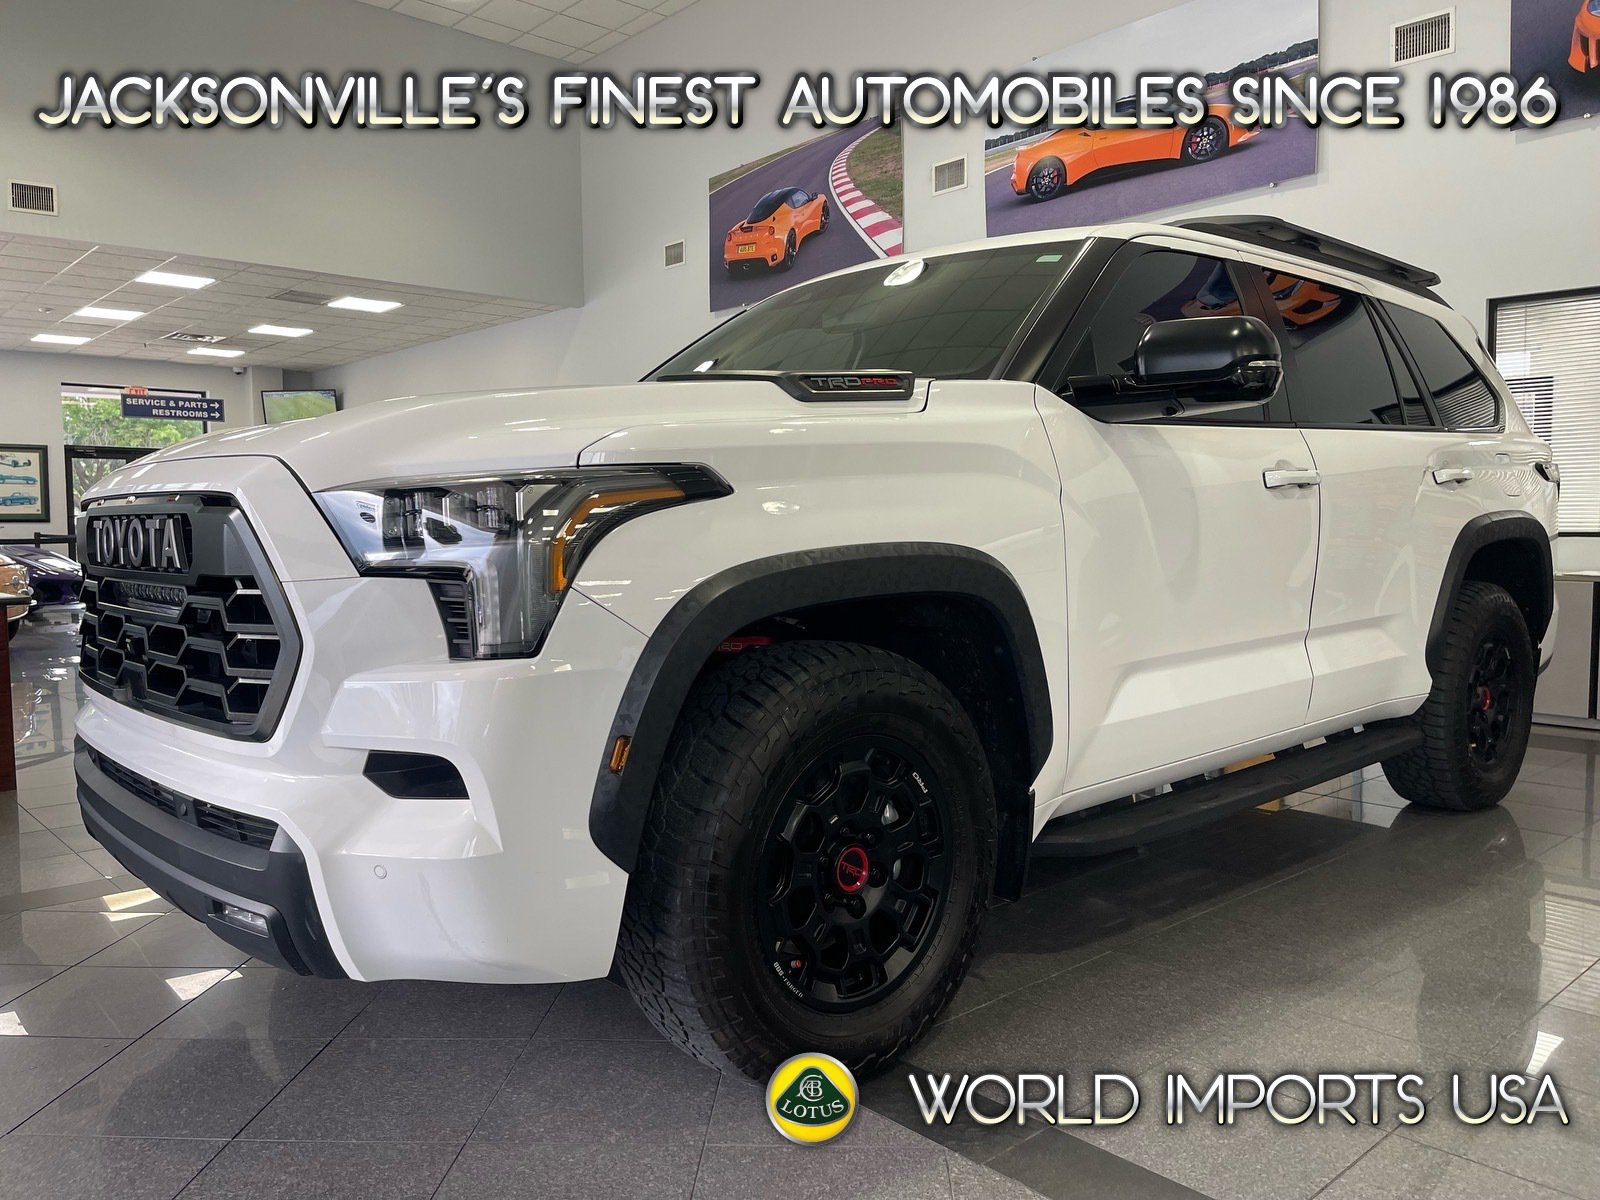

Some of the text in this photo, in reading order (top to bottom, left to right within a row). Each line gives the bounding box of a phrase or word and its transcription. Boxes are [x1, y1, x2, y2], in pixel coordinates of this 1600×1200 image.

[126, 398, 208, 409] SERVICE & PARTS
[152, 409, 208, 418] RESTROOMS
[93, 517, 186, 570] TOYOTA
